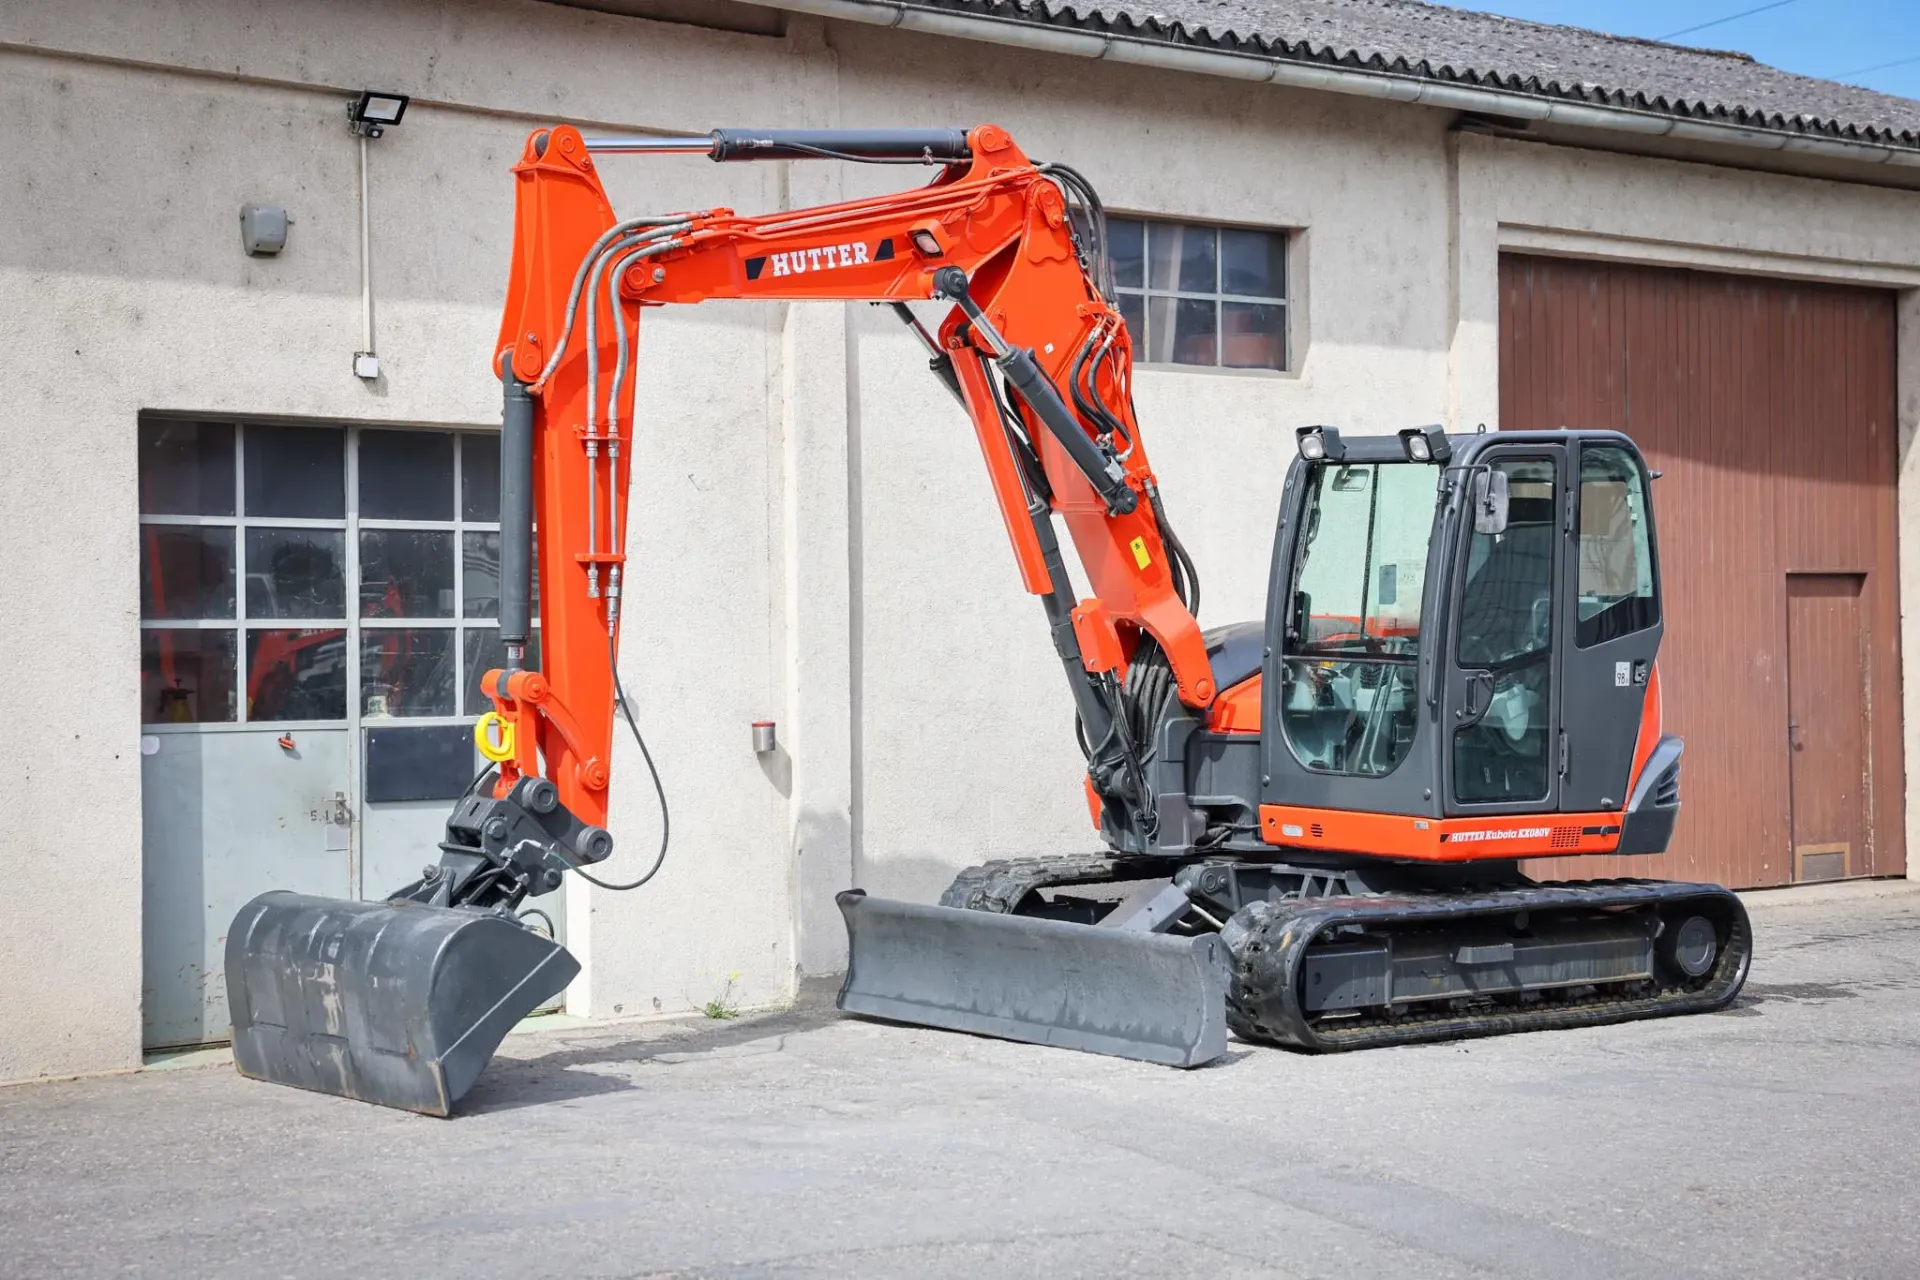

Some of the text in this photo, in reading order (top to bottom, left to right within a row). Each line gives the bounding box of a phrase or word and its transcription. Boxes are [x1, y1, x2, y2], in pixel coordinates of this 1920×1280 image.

[770, 241, 870, 277] HUTTER
[1451, 831, 1485, 843] HUTTER
[1485, 830, 1518, 841] Kubota
